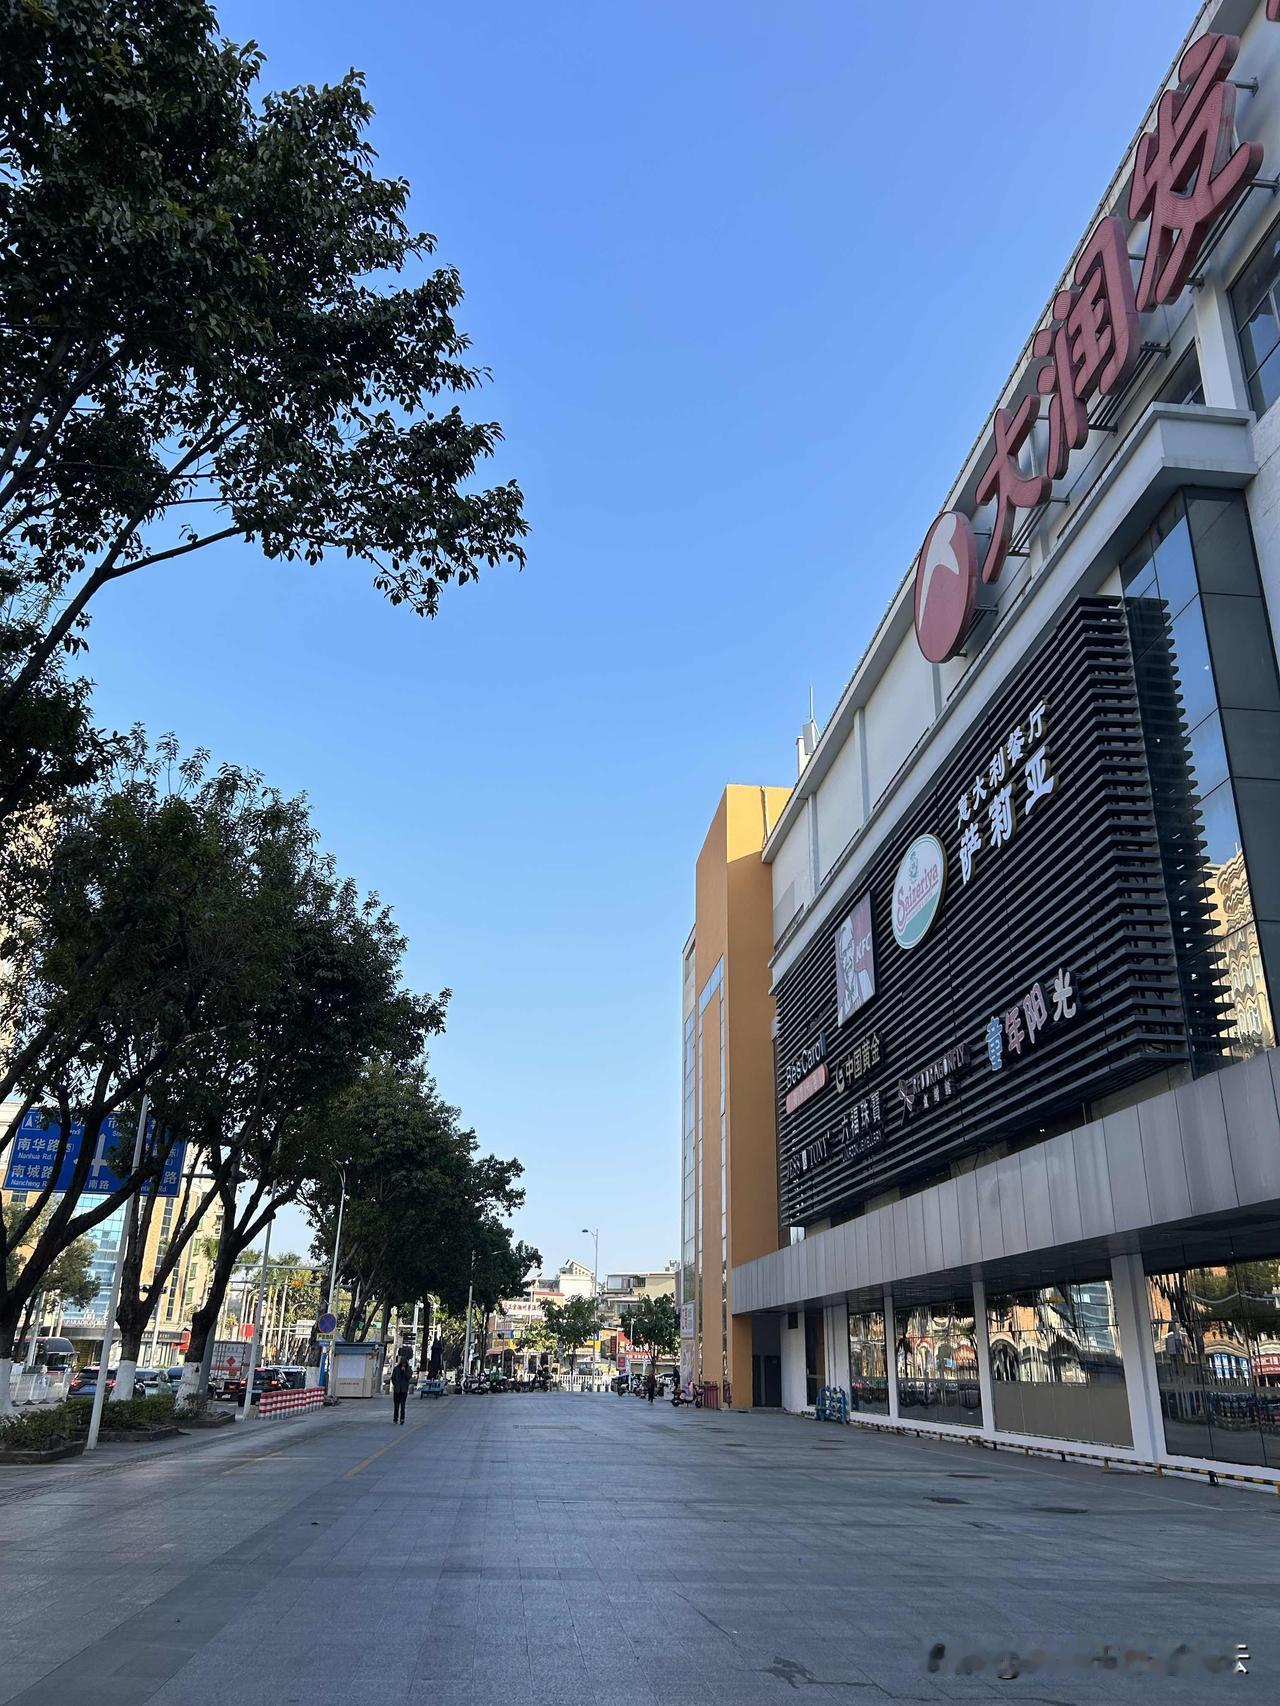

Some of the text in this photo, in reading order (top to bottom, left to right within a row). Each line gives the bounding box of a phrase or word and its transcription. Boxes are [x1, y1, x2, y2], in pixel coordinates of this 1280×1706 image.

[957, 701, 1048, 829] 意大利餐厅
[959, 746, 1058, 885] 萨莉亚
[896, 863, 939, 933] Saizeriya
[855, 932, 871, 963] KFC
[845, 1032, 880, 1085] 中国黄金
